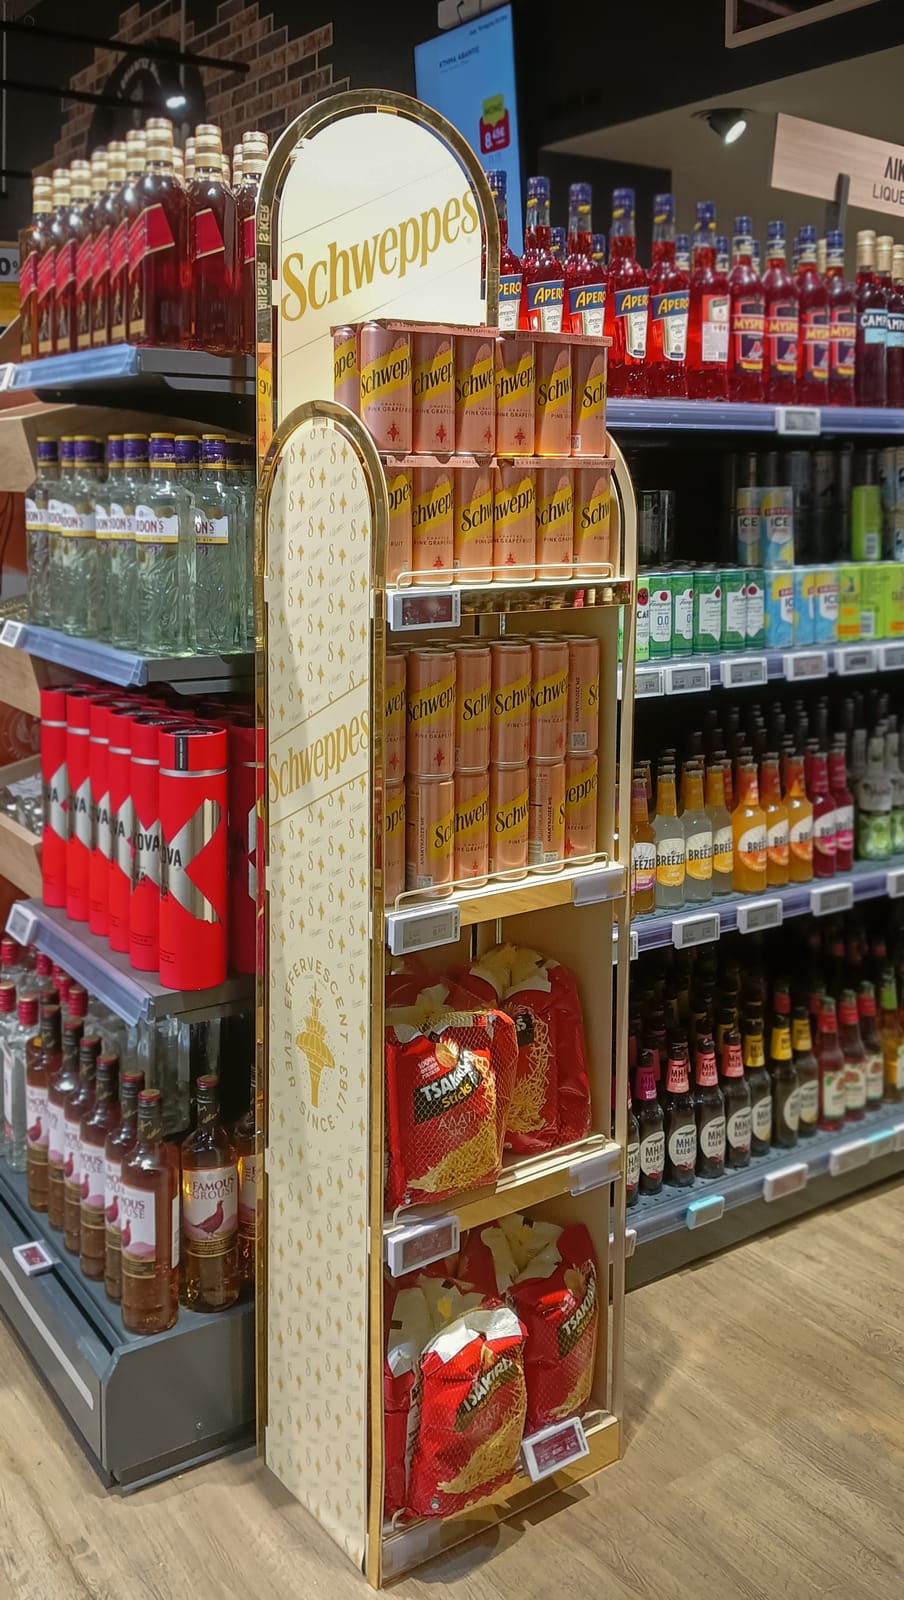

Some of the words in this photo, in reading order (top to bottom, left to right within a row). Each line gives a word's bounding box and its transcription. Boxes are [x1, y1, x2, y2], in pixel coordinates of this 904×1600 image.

[281, 190, 479, 322] Schweppes
[739, 516, 759, 528] ICE
[770, 515, 789, 527] ICE
[269, 710, 369, 804] Schweppes
[284, 956, 349, 1044] EFFERVESCENT
[284, 1031, 297, 1088] EVER
[299, 1100, 336, 1132] SINCE
[336, 1065, 349, 1114] 1783
[192, 1175, 234, 1195] FAMOUS
